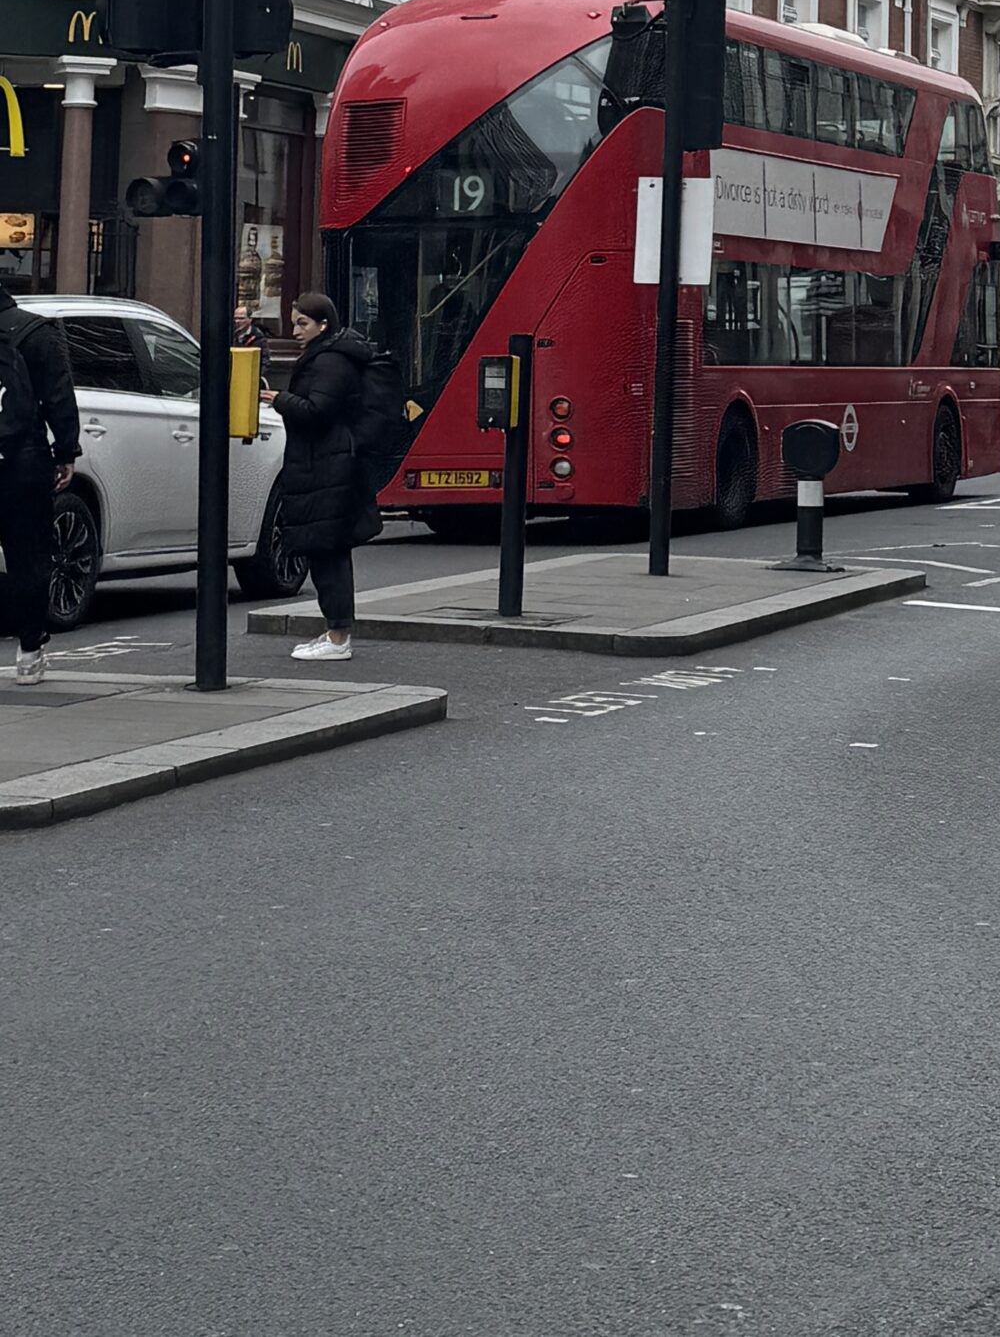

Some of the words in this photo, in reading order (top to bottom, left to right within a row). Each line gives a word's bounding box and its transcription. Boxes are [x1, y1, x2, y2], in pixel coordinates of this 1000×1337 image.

[453, 175, 485, 211] 19
[715, 175, 752, 203] Divorce
[779, 191, 786, 208] a
